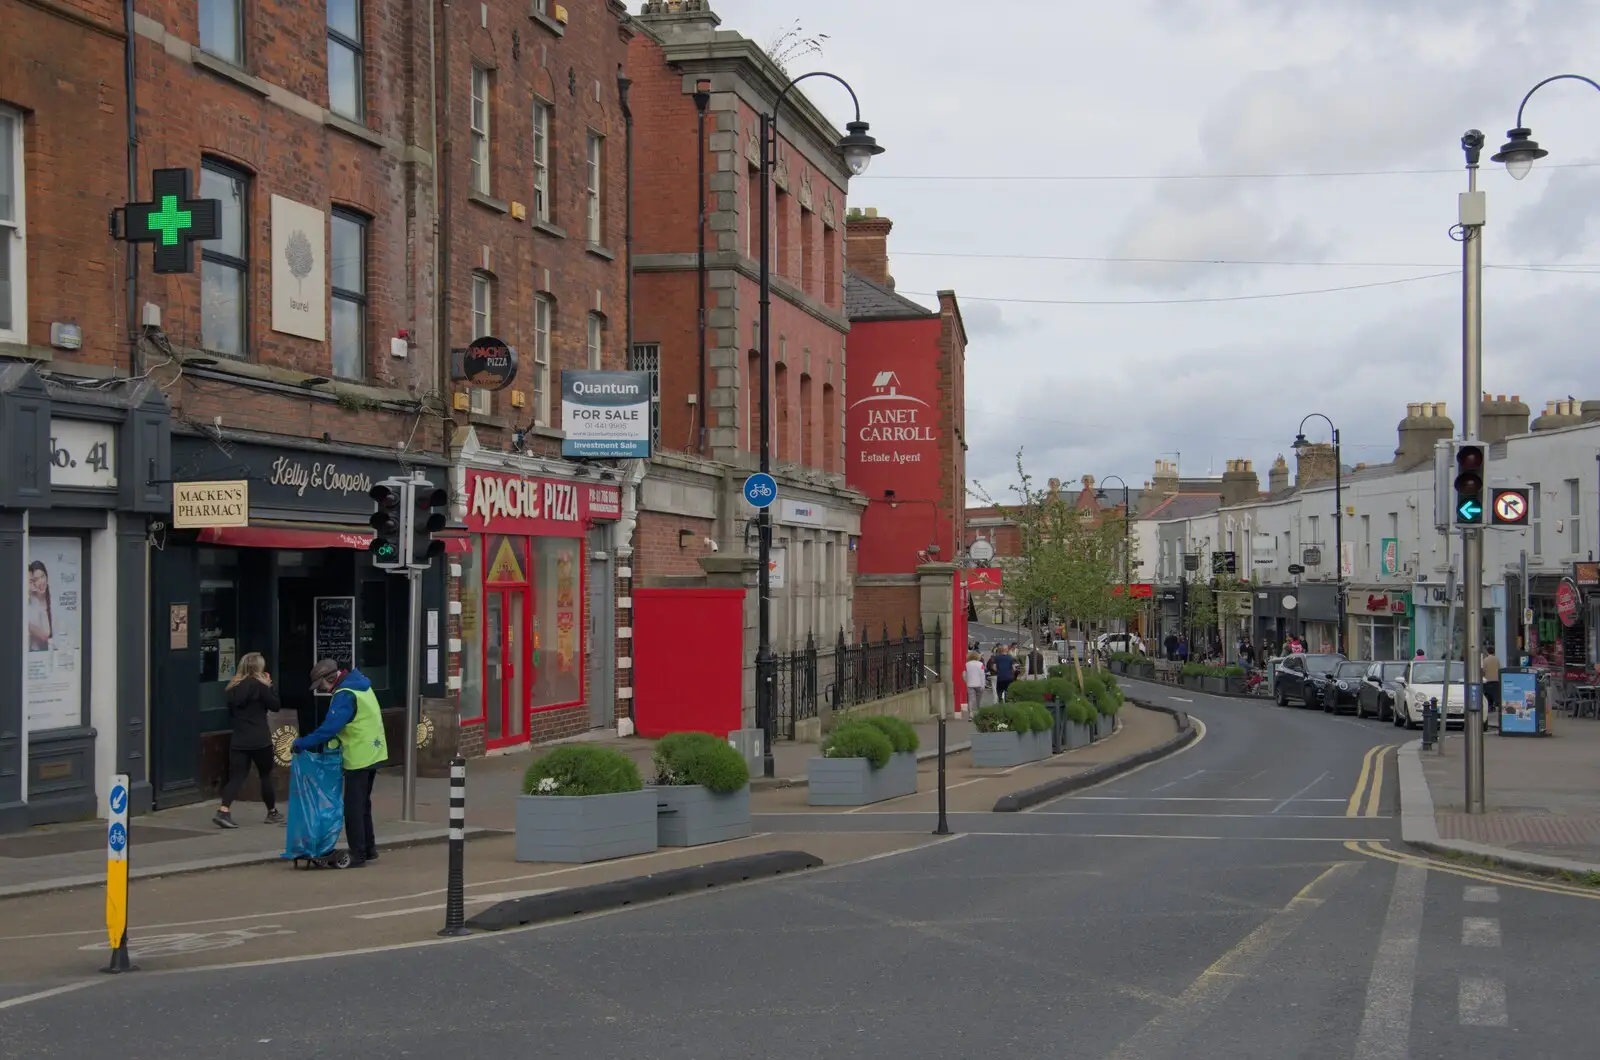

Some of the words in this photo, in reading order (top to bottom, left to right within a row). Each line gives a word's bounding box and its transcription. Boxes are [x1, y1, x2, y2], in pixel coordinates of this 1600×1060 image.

[289, 296, 309, 312] laurel
[466, 346, 508, 359] APACHE
[487, 357, 508, 367] PIZZA
[573, 381, 639, 396] Quantum
[573, 410, 600, 420] FOR
[605, 410, 639, 420] SALE
[868, 409, 919, 426] JANET
[860, 426, 937, 441] CARROLL
[85, 441, 109, 473] 41
[860, 451, 890, 462] Estate
[893, 451, 921, 464] Agent
[271, 456, 310, 497] Kelly
[311, 462, 322, 488] &
[323, 463, 372, 497] Coopers
[180, 488, 242, 502] MACKEN'S
[472, 475, 540, 527] APACHE
[544, 482, 579, 521] PIZZA
[178, 503, 243, 517] PHARMACY
